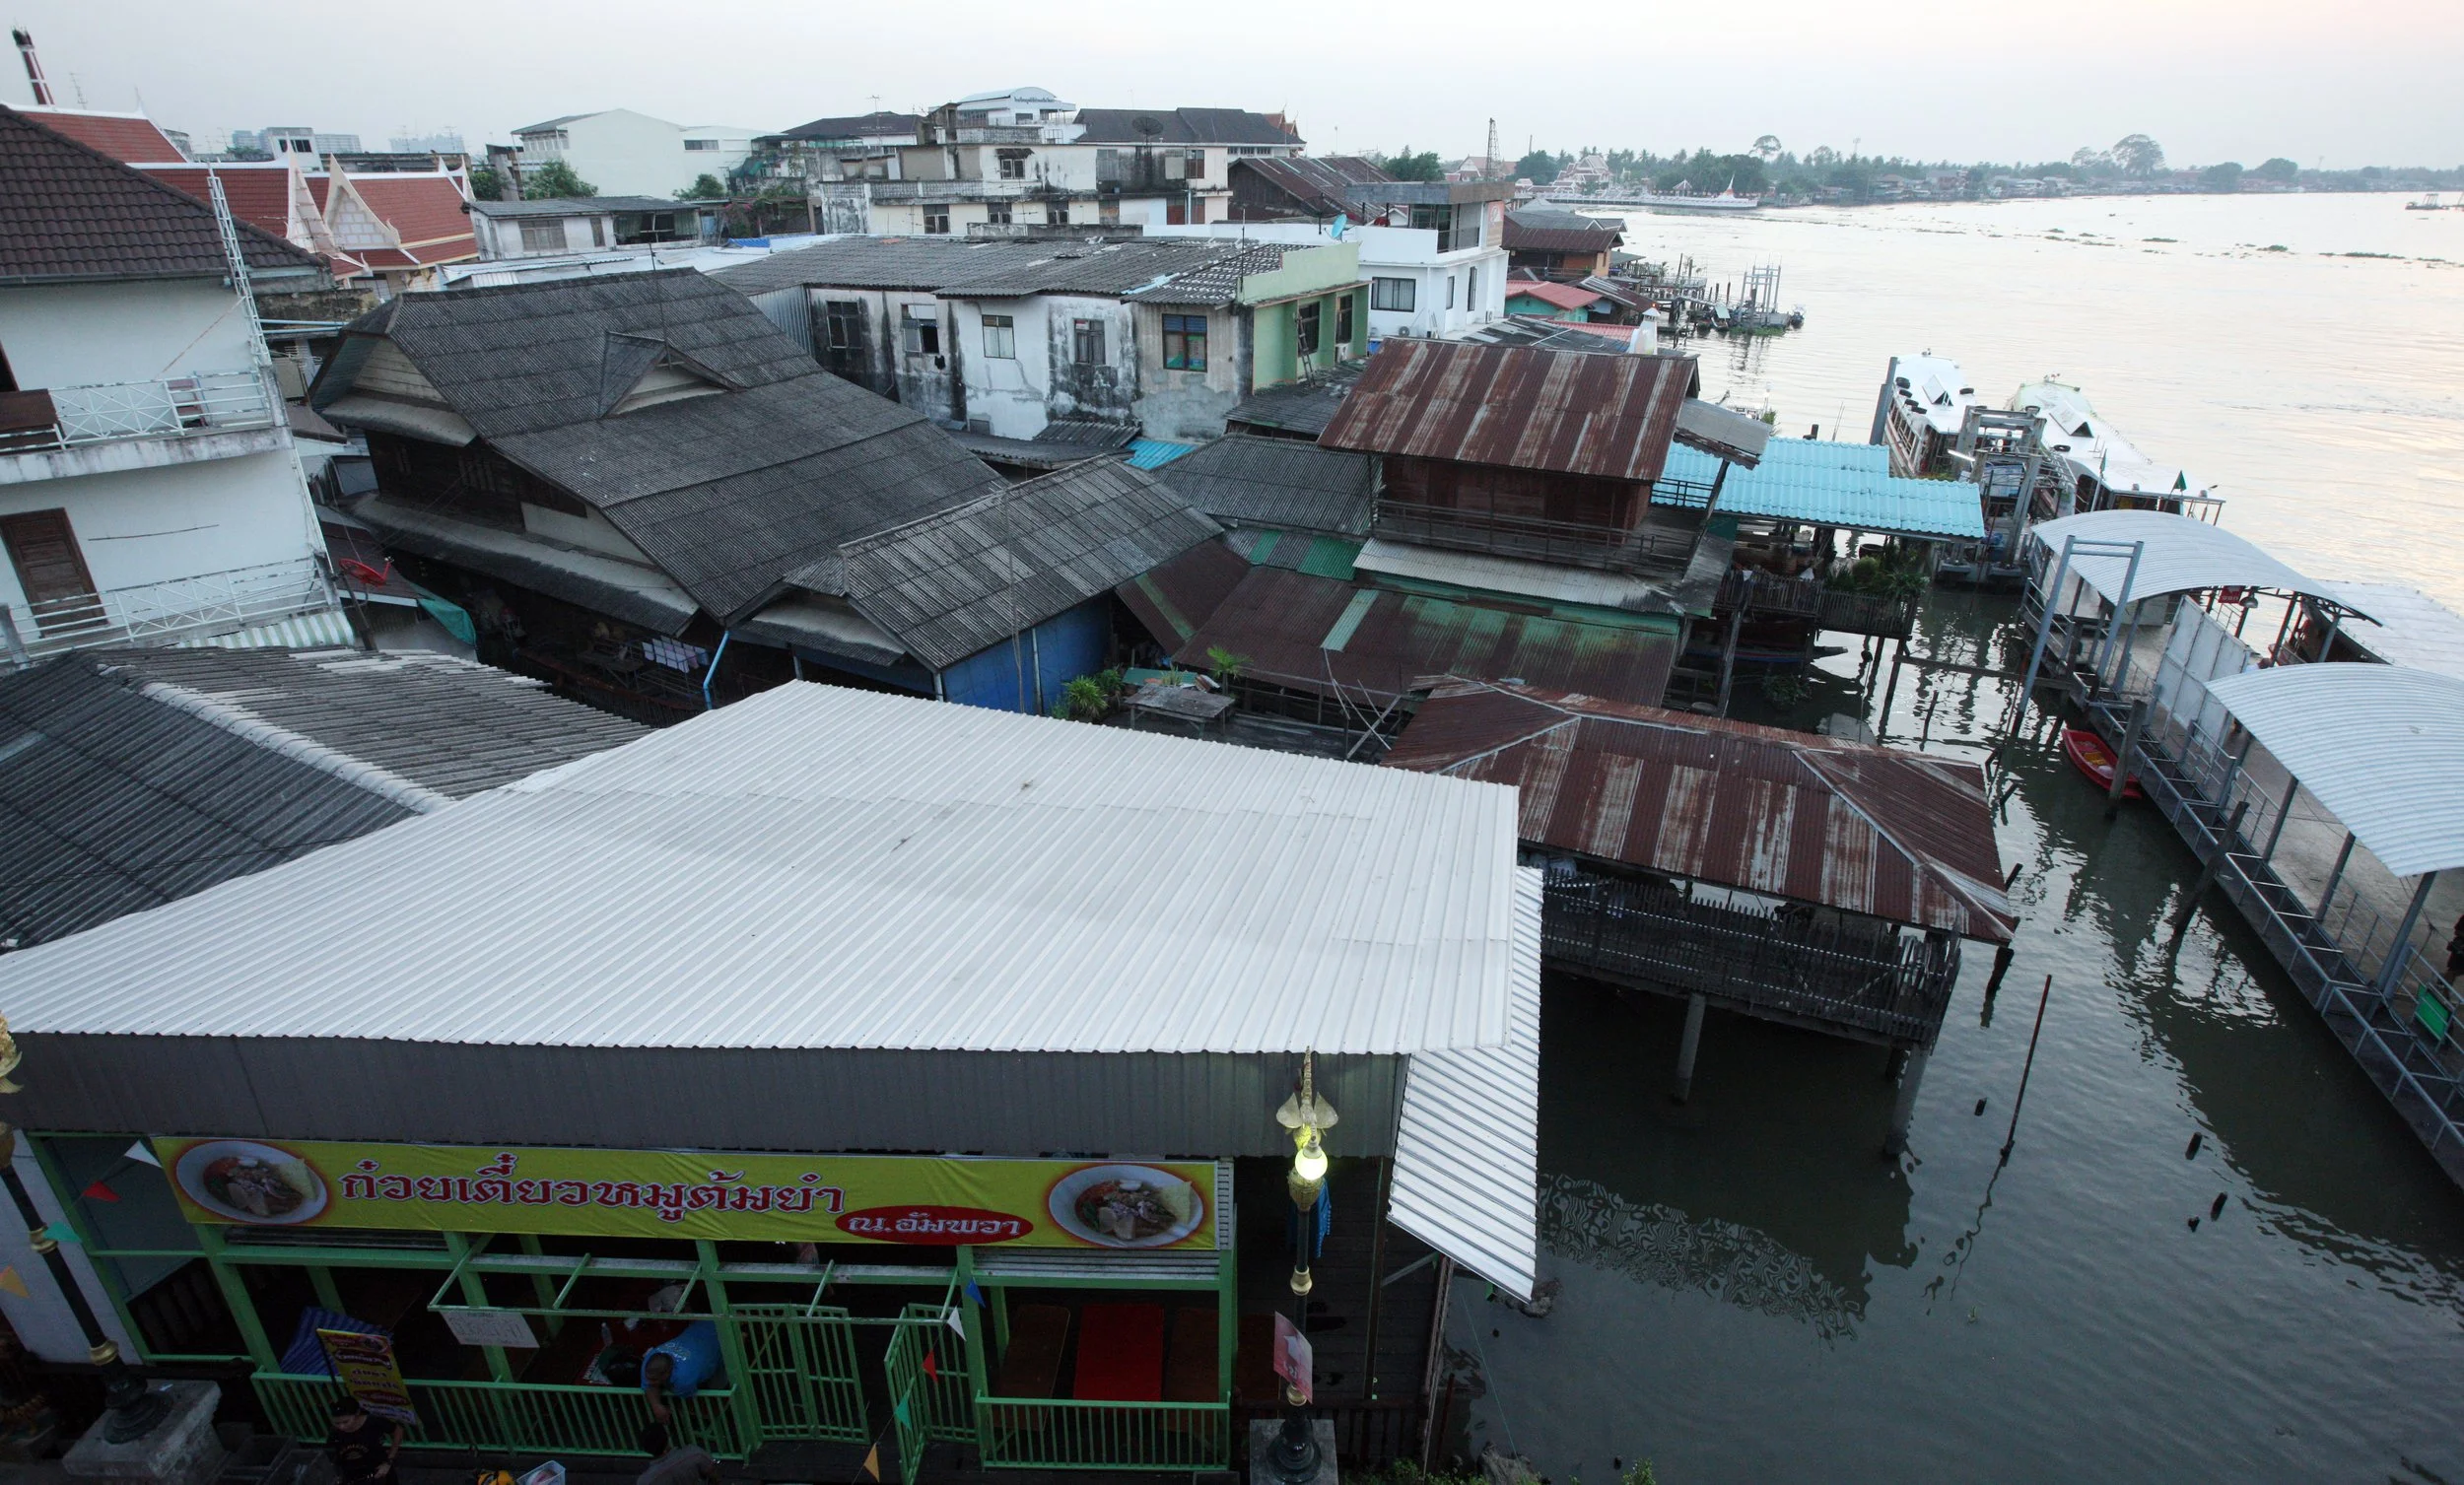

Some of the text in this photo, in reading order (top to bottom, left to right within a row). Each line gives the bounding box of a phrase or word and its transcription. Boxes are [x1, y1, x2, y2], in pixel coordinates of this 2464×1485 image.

[338, 1151, 846, 1223] ก๋วยเตี๋ยวหมูต้มยำ
